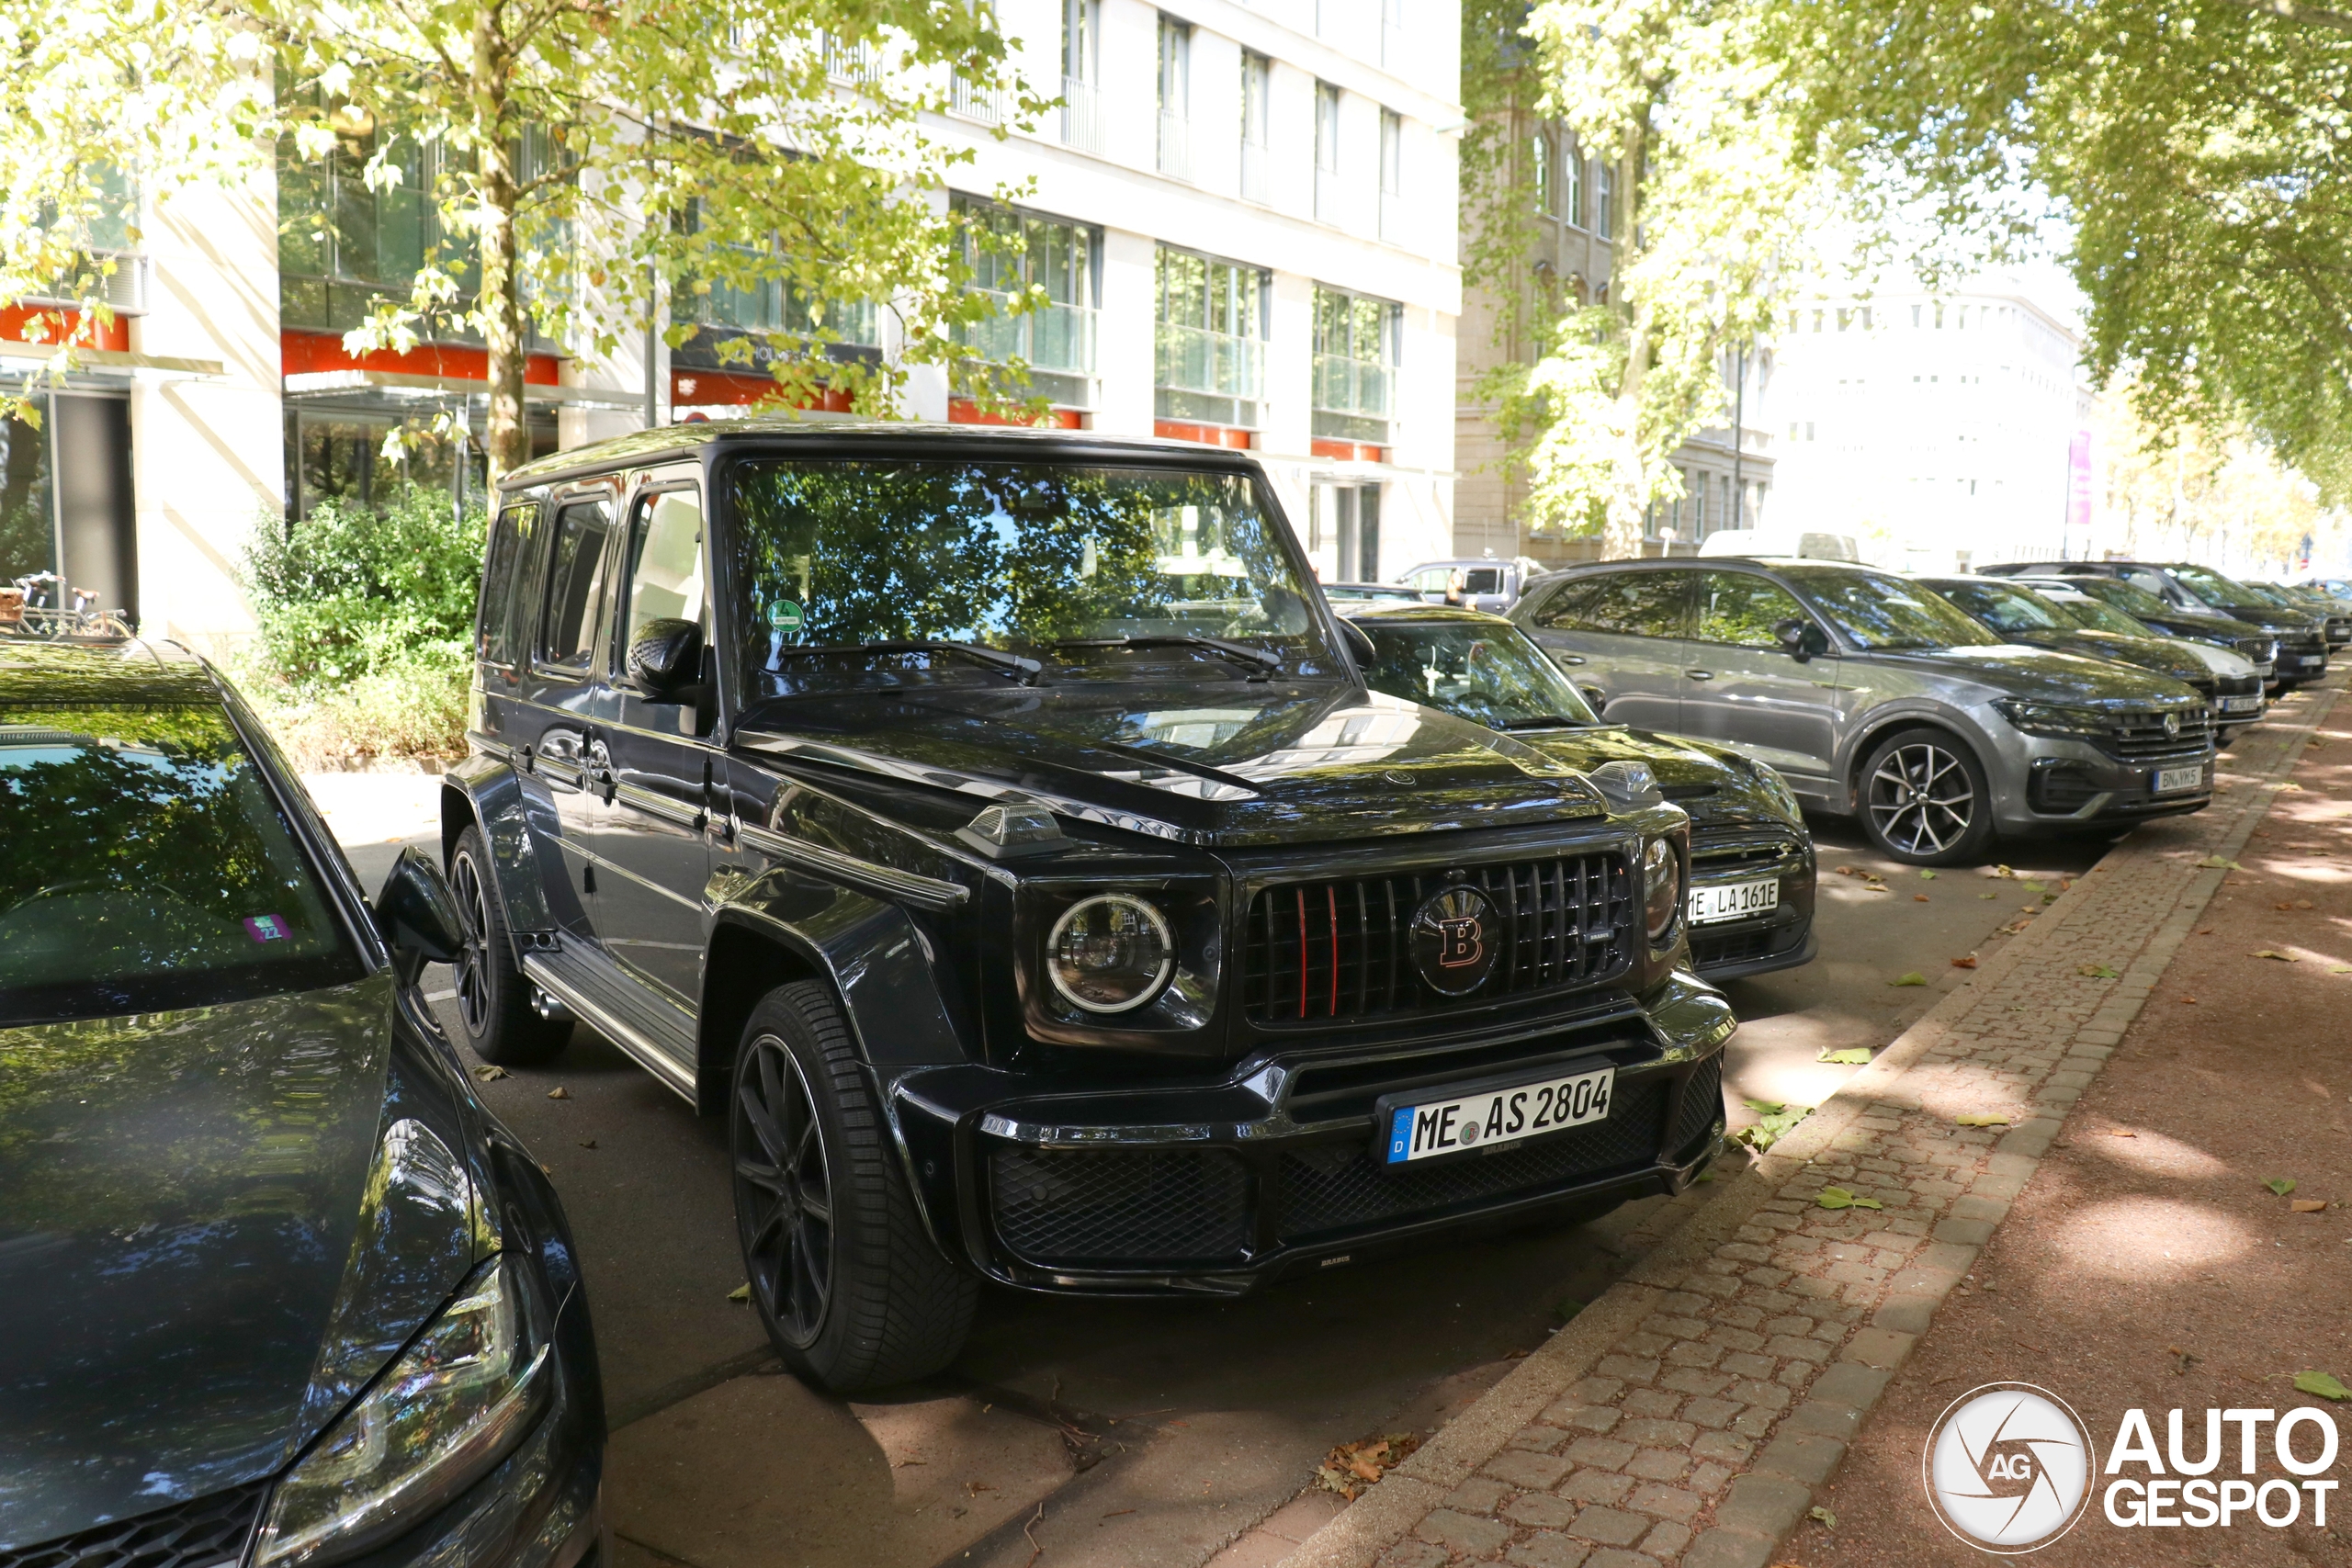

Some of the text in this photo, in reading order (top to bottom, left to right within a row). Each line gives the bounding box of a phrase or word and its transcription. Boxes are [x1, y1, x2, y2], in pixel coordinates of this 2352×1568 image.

[780, 602, 790, 616] 4
[2163, 773, 2175, 788] BN
[1718, 888, 1736, 913] LA
[1741, 883, 1776, 910] 161E
[260, 926, 283, 940] 22
[1440, 918, 1482, 967] B
[1394, 1075, 1608, 1153] D ME AS 2804
[1482, 1139, 1523, 1156] BRABUS
[1321, 1255, 1351, 1267] BRABUS
